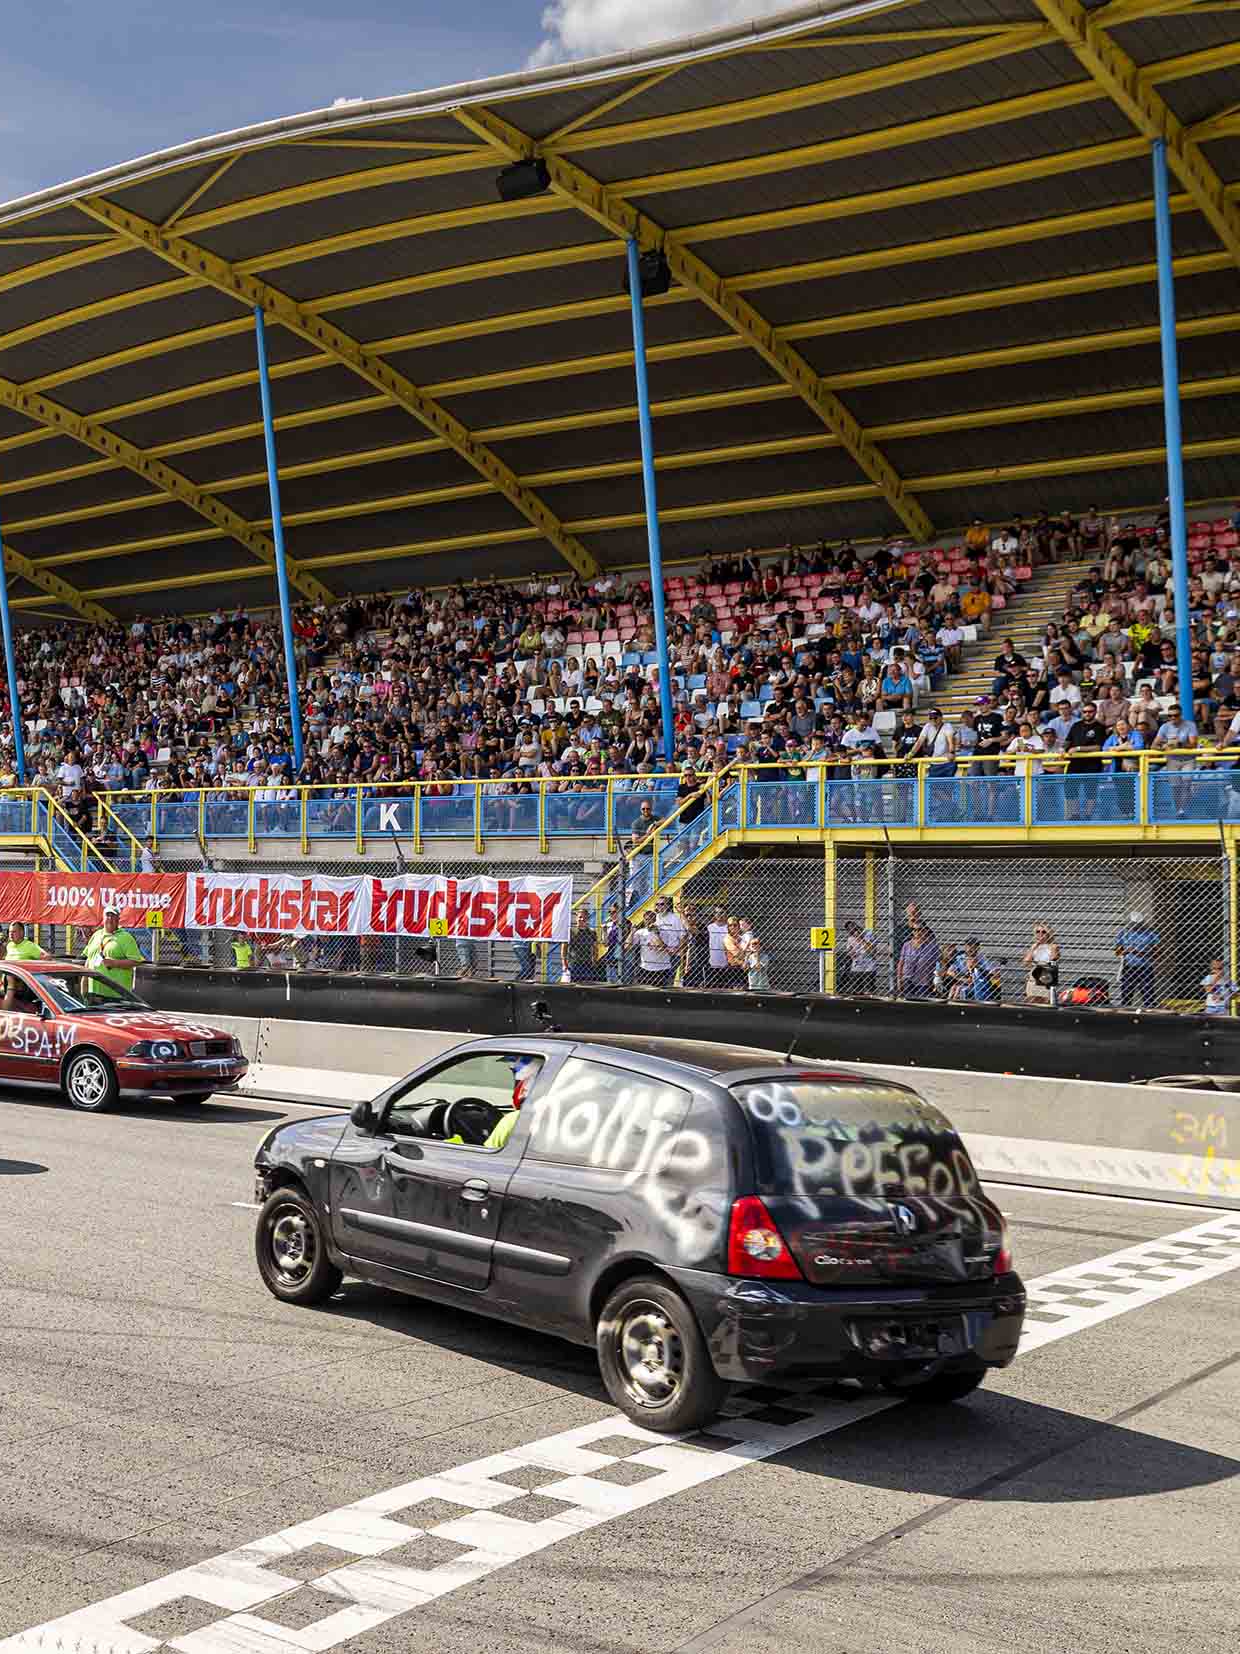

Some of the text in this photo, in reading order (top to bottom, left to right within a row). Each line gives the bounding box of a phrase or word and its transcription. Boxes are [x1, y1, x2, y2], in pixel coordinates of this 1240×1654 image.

[380, 803, 401, 830] K
[47, 886, 172, 910] 100% Uptime
[194, 877, 355, 931] truckstar
[371, 878, 563, 938] truckstar
[150, 914, 158, 925] 4
[436, 920, 443, 935] 3
[821, 930, 830, 946] 2
